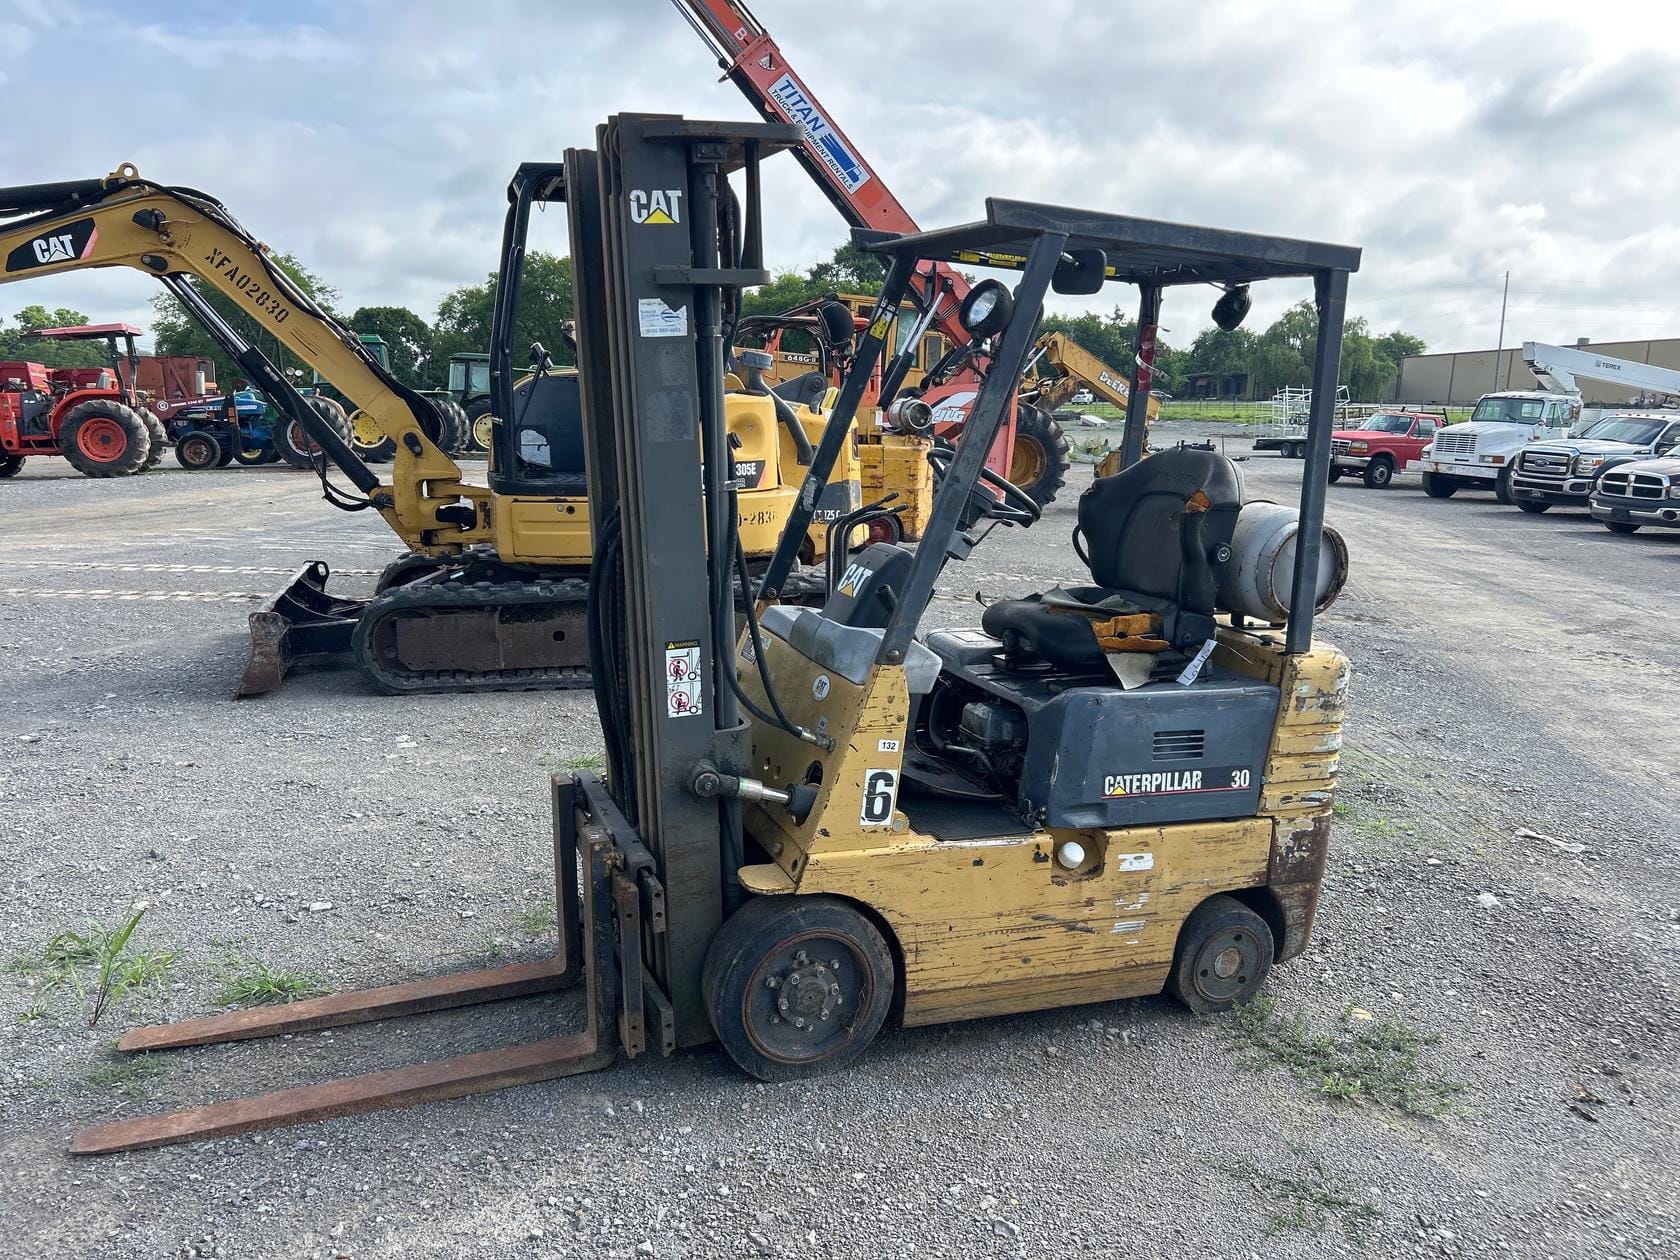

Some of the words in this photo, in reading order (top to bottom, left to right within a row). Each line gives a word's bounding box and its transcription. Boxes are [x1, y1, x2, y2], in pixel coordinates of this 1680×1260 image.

[779, 79, 825, 132] TITAN
[772, 89, 792, 114] TRUCK
[790, 113, 797, 121] &
[796, 119, 829, 158] EUIPMENT
[827, 159, 853, 190] RENTALS
[629, 189, 682, 224] CAT
[32, 233, 76, 263] CAT
[204, 247, 290, 324] XFA02830
[1602, 362, 1622, 370] TEREX
[932, 408, 966, 422] JLG
[735, 462, 757, 476] 305E
[837, 563, 874, 598] CAT
[881, 741, 897, 750] 132
[864, 771, 894, 822] 6
[1104, 770, 1203, 796] CATERPILLAR
[1230, 769, 1250, 788] 30
